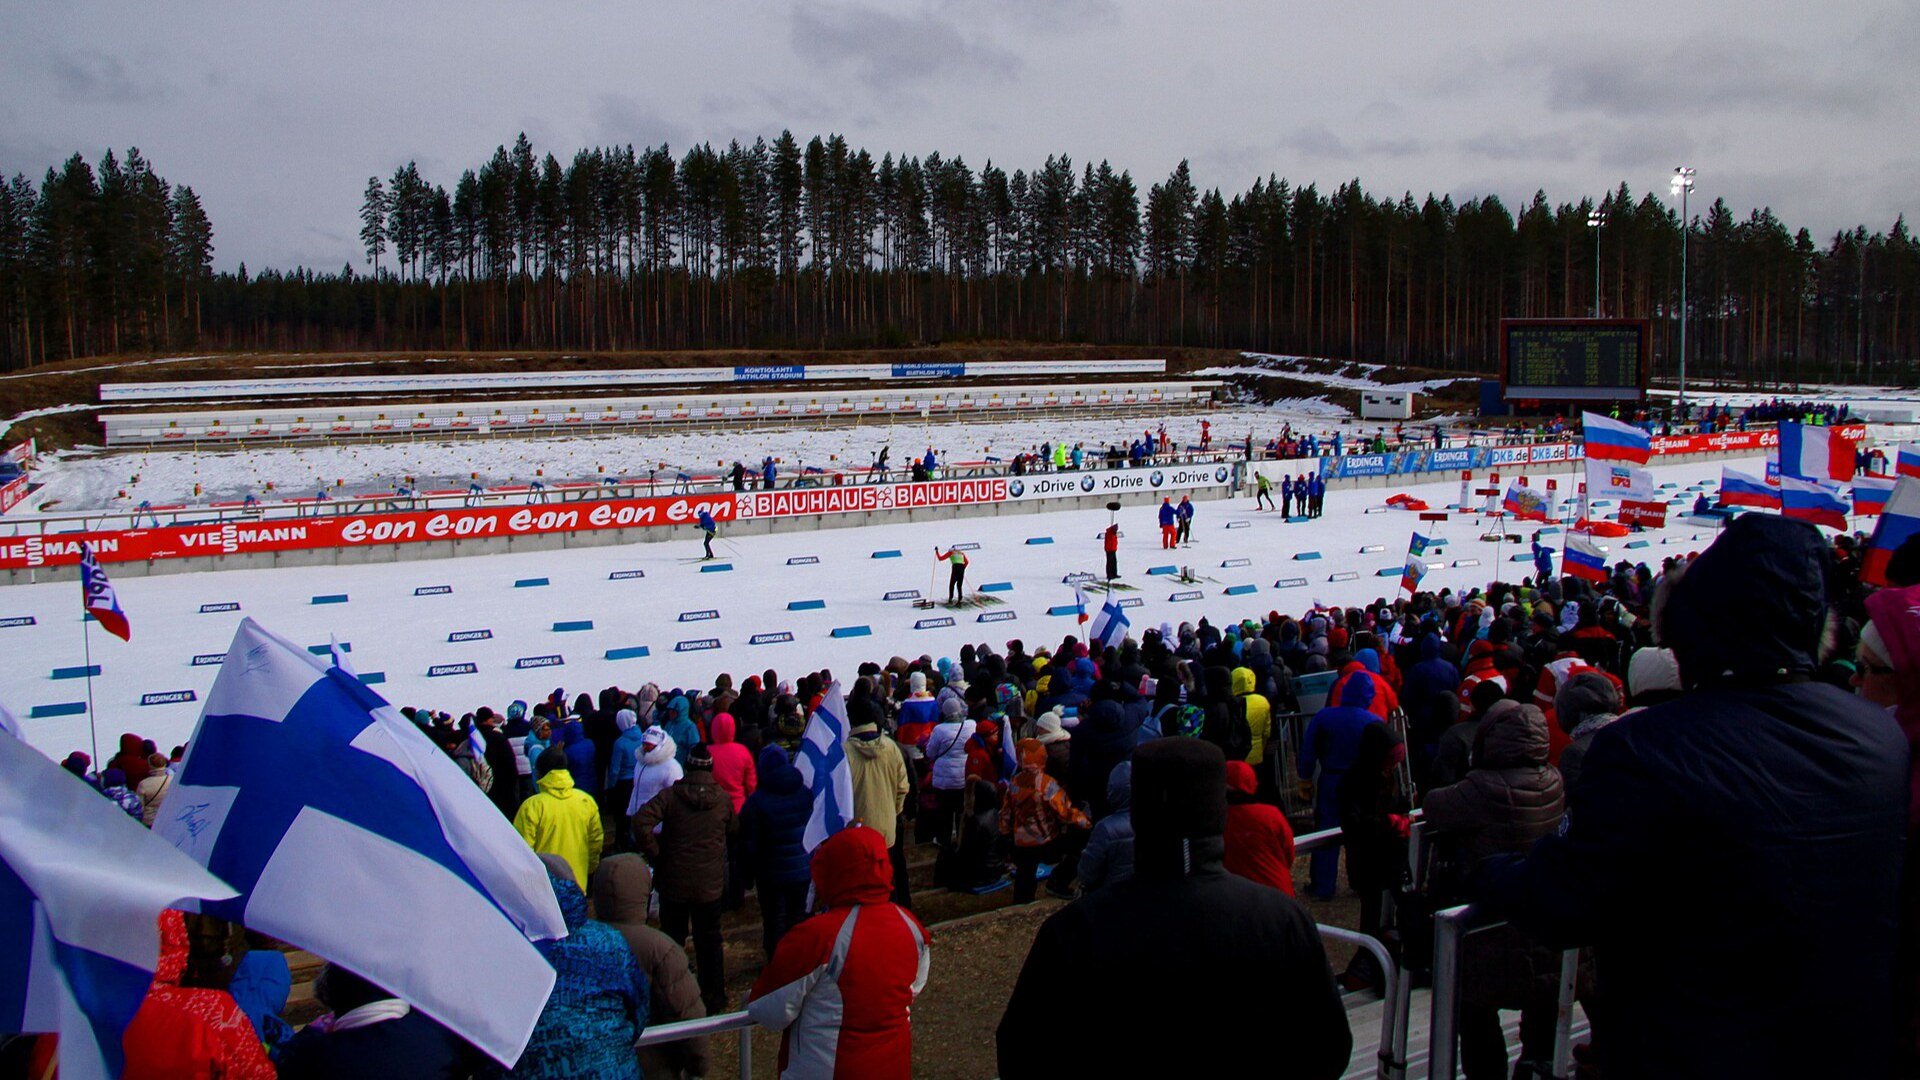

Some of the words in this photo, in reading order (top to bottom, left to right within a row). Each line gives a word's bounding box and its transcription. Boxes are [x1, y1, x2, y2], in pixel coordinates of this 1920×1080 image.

[1650, 438, 1690, 454] IESSMANN
[1434, 451, 1469, 462] ERDINGER
[1492, 449, 1528, 463] DKB.de
[1531, 446, 1565, 460] DKB.de
[1347, 457, 1384, 468] ERDINGER
[1103, 475, 1144, 489] xDrive
[1172, 471, 1209, 484] xDrive
[1033, 479, 1075, 494] xDrive
[896, 481, 1006, 505] BAUHAUS
[756, 489, 877, 514] BAUHAUS
[1620, 507, 1665, 518] VIESSMANN
[0, 537, 118, 566] IESSMANN
[180, 525, 307, 553] VIESSMANN
[613, 571, 637, 579] ERDINGER
[418, 586, 443, 594] ERDINGER
[203, 604, 230, 612] ERDINGER
[684, 612, 710, 620] ERDINGER
[453, 632, 482, 641] ERDINGER
[755, 634, 784, 643] ERDINGER
[680, 641, 711, 650] ERDINGER
[520, 658, 553, 667] ERDINGER
[432, 665, 466, 675] ERDINGER
[145, 693, 183, 704] ERDINGER
